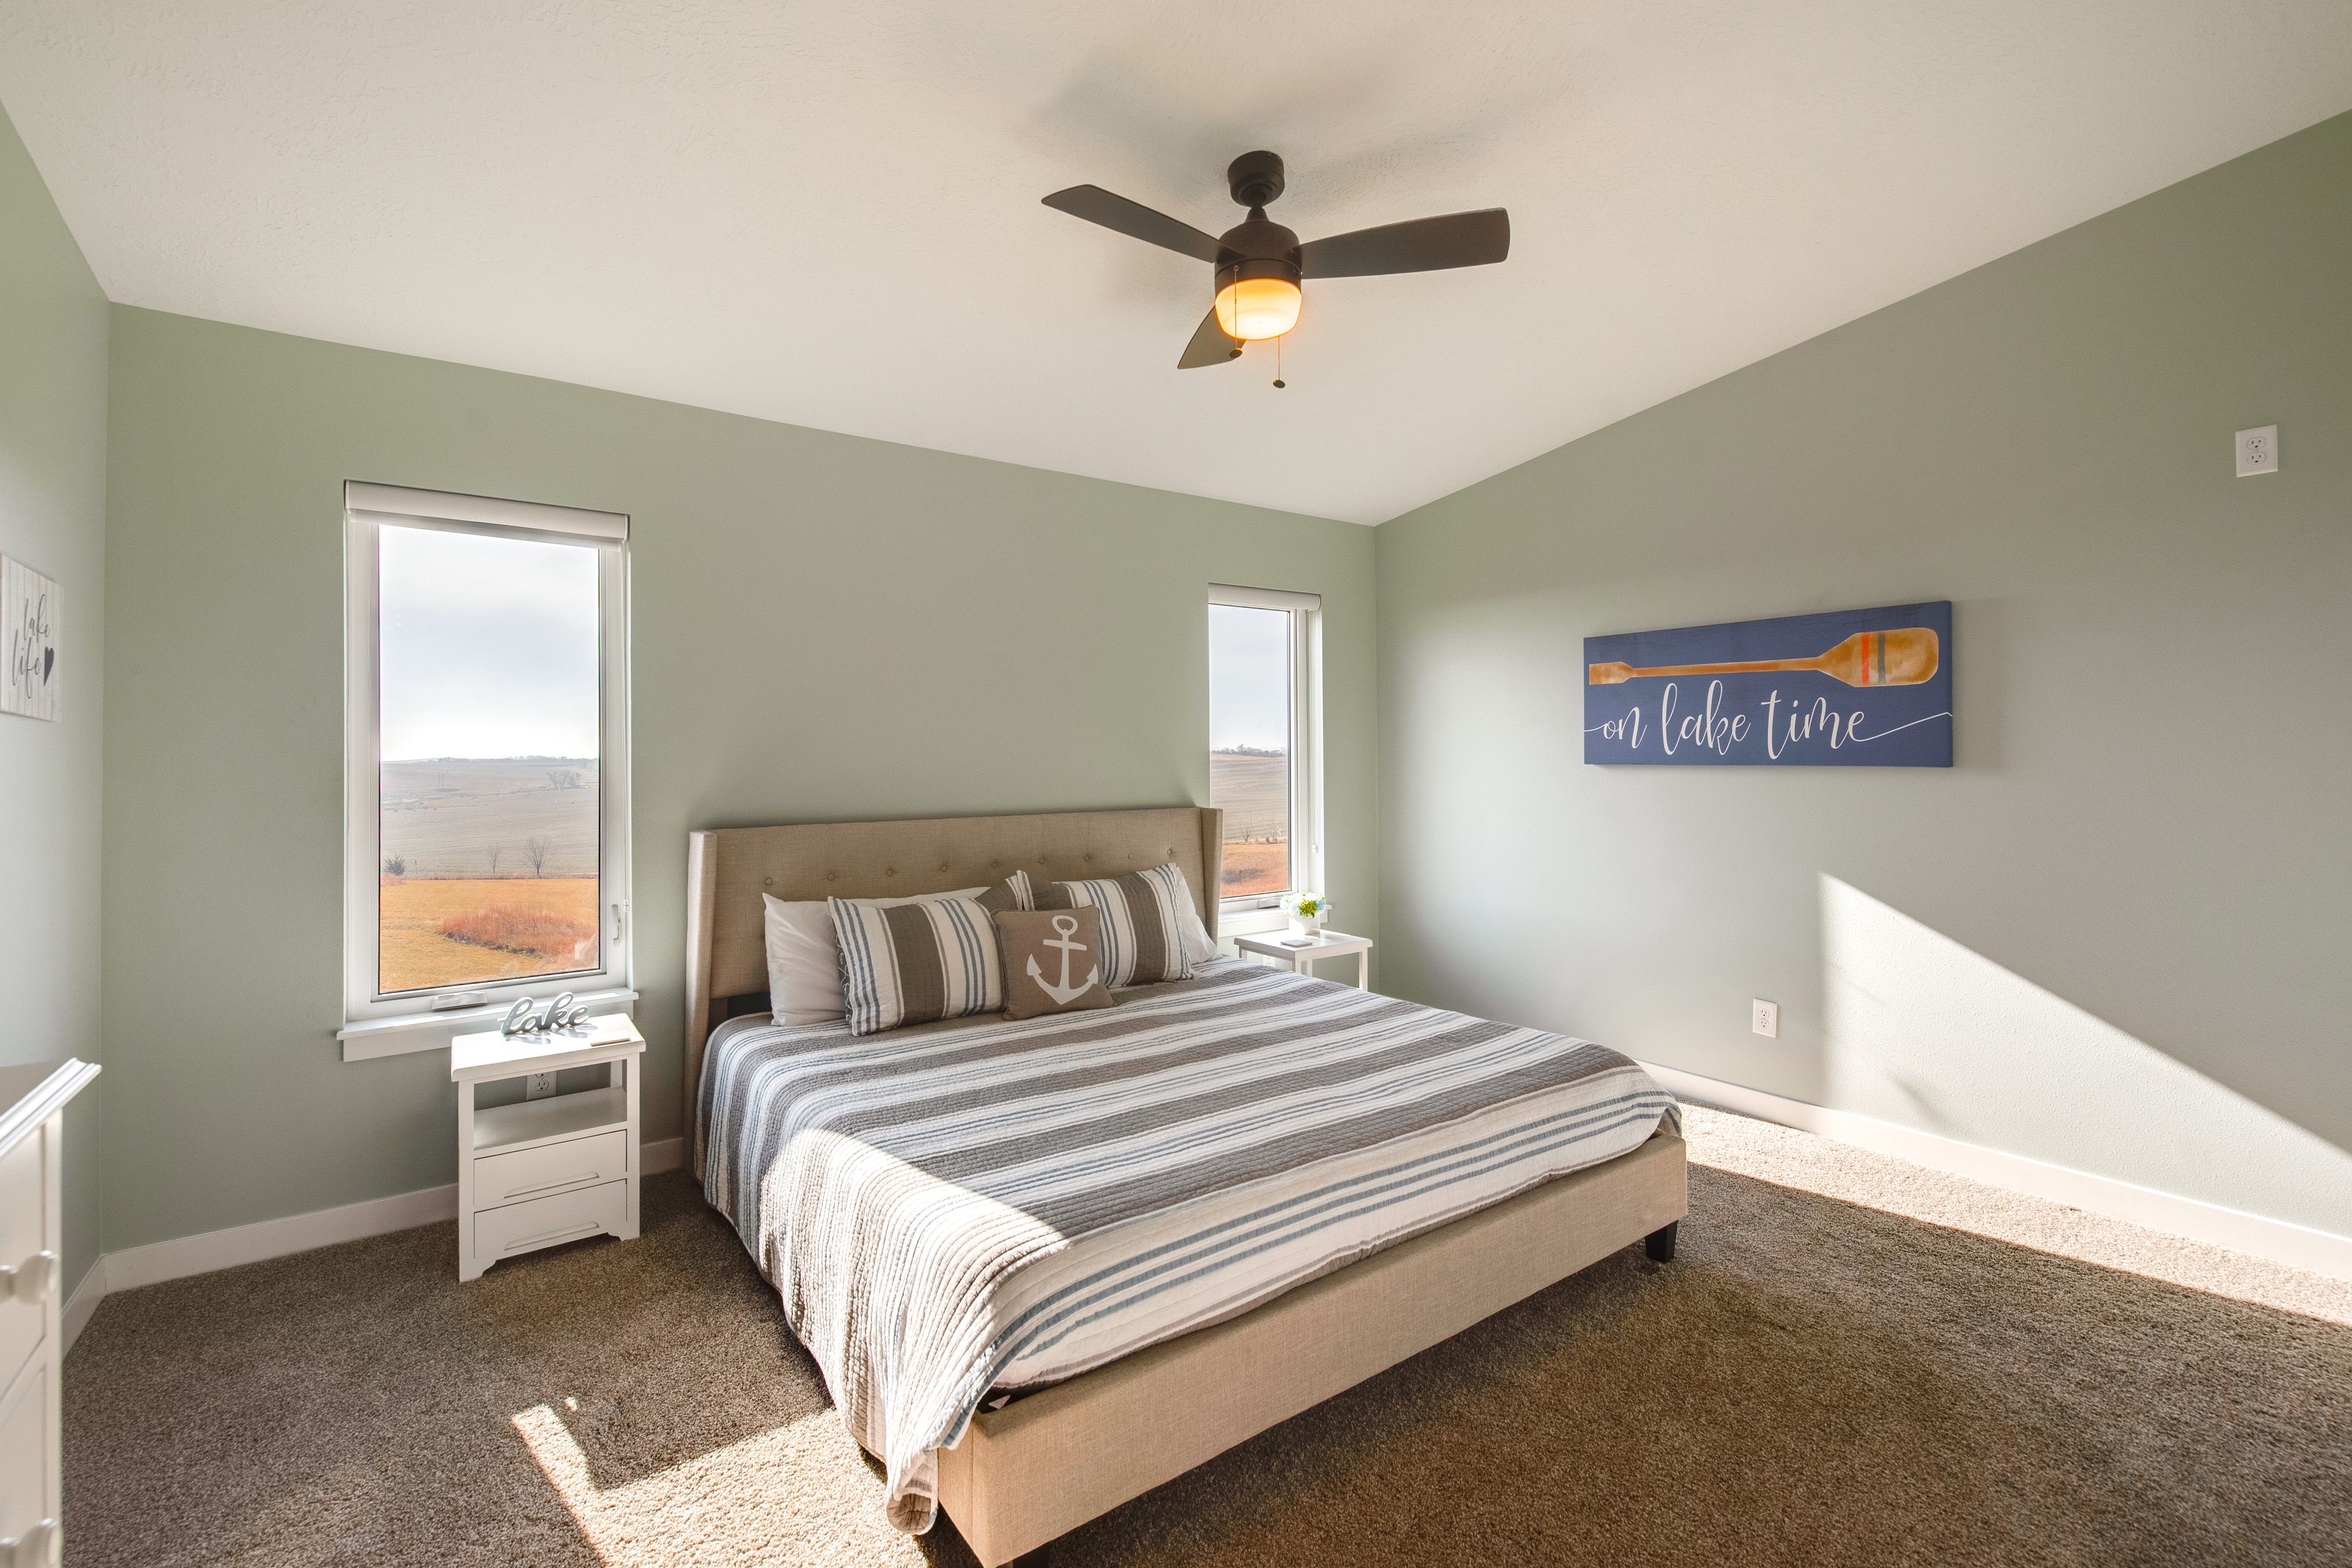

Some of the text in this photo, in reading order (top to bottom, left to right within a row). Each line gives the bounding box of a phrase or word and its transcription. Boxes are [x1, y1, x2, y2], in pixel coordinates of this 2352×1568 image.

[23, 594, 50, 643] lake
[12, 629, 41, 699] life
[1600, 680, 1877, 760] on lake time
[497, 991, 589, 1035] lake
